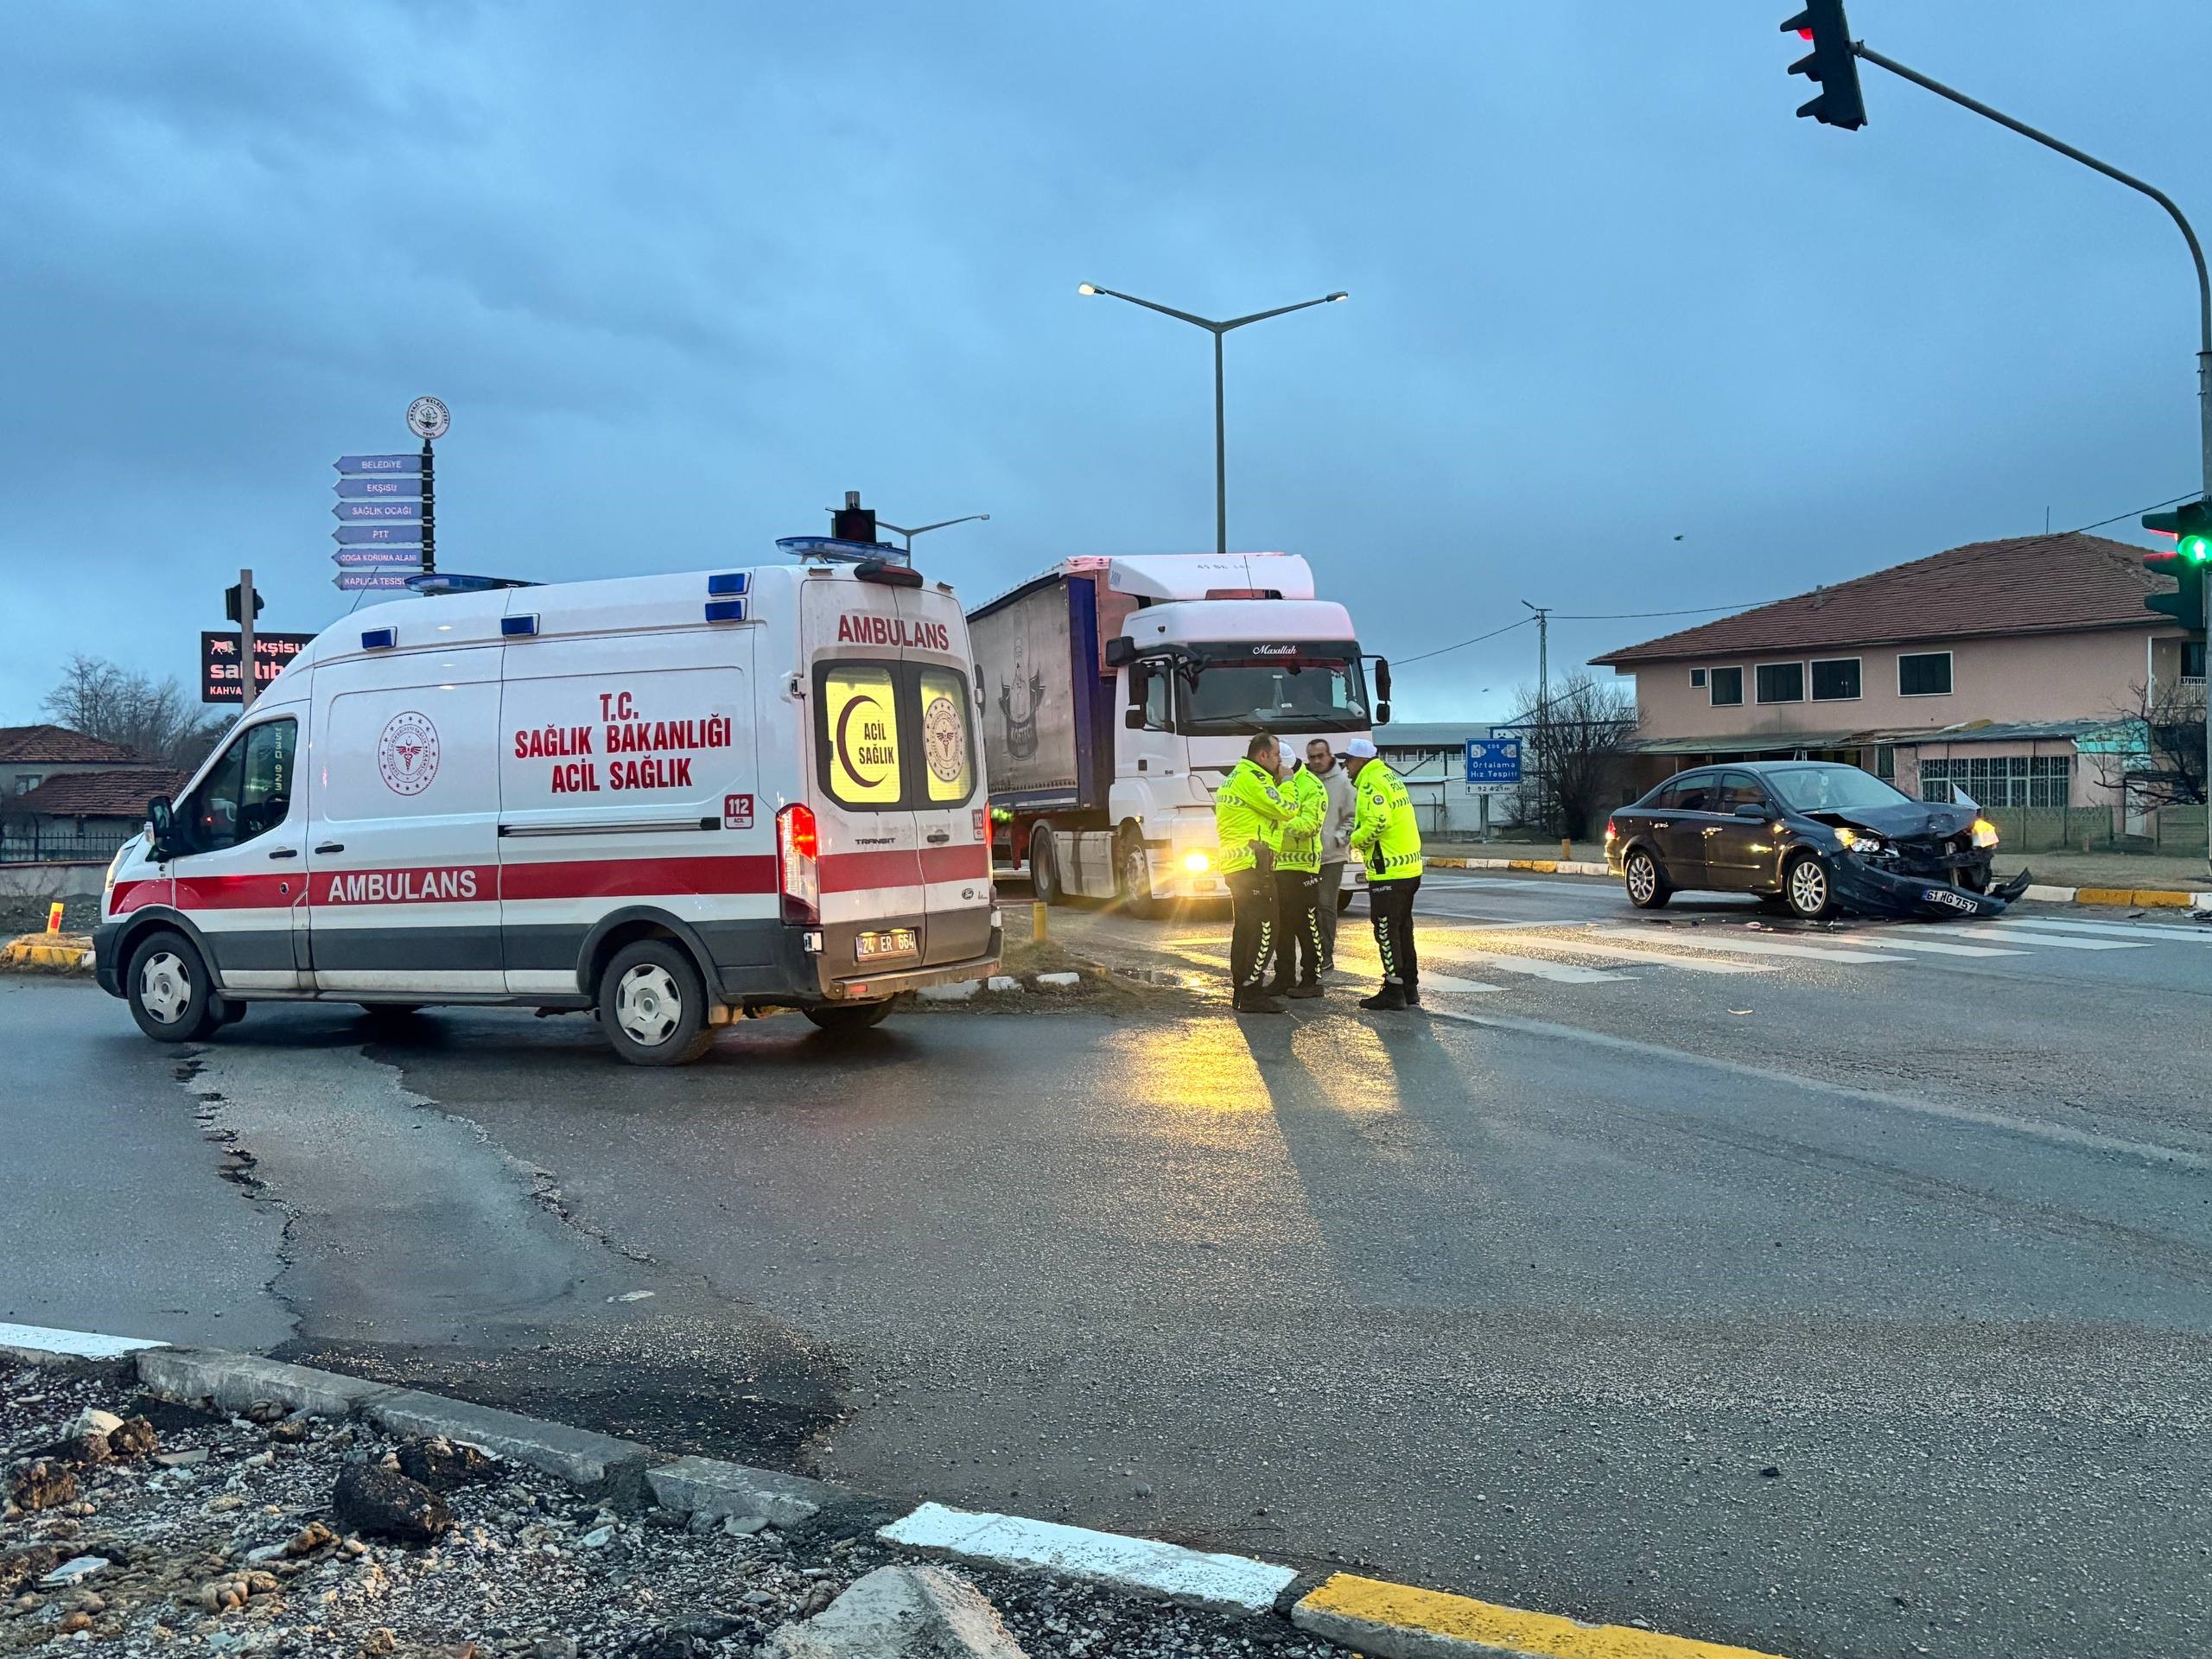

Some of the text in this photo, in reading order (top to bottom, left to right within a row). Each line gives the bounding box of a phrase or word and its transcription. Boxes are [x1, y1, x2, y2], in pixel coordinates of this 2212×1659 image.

[361, 461, 402, 469] BELEDİYE
[366, 483, 397, 493] EKŞİSU
[352, 505, 411, 515] SAĞLIK OCAĞI
[837, 614, 950, 651] AMBULANS
[599, 691, 639, 722] T.C.
[514, 713, 732, 759] SAĞLIK BAKANLIĞI
[863, 719, 887, 741] ACİL
[858, 743, 895, 765] SAĞLIK
[551, 753, 693, 794] ACİL SAĞLIK
[1487, 770, 1517, 779] Tespiti
[728, 798, 749, 815] 112
[327, 869, 477, 902] AMBULANS
[1926, 891, 1977, 912] 61 HG 757
[862, 933, 914, 954] 24 ER 664
